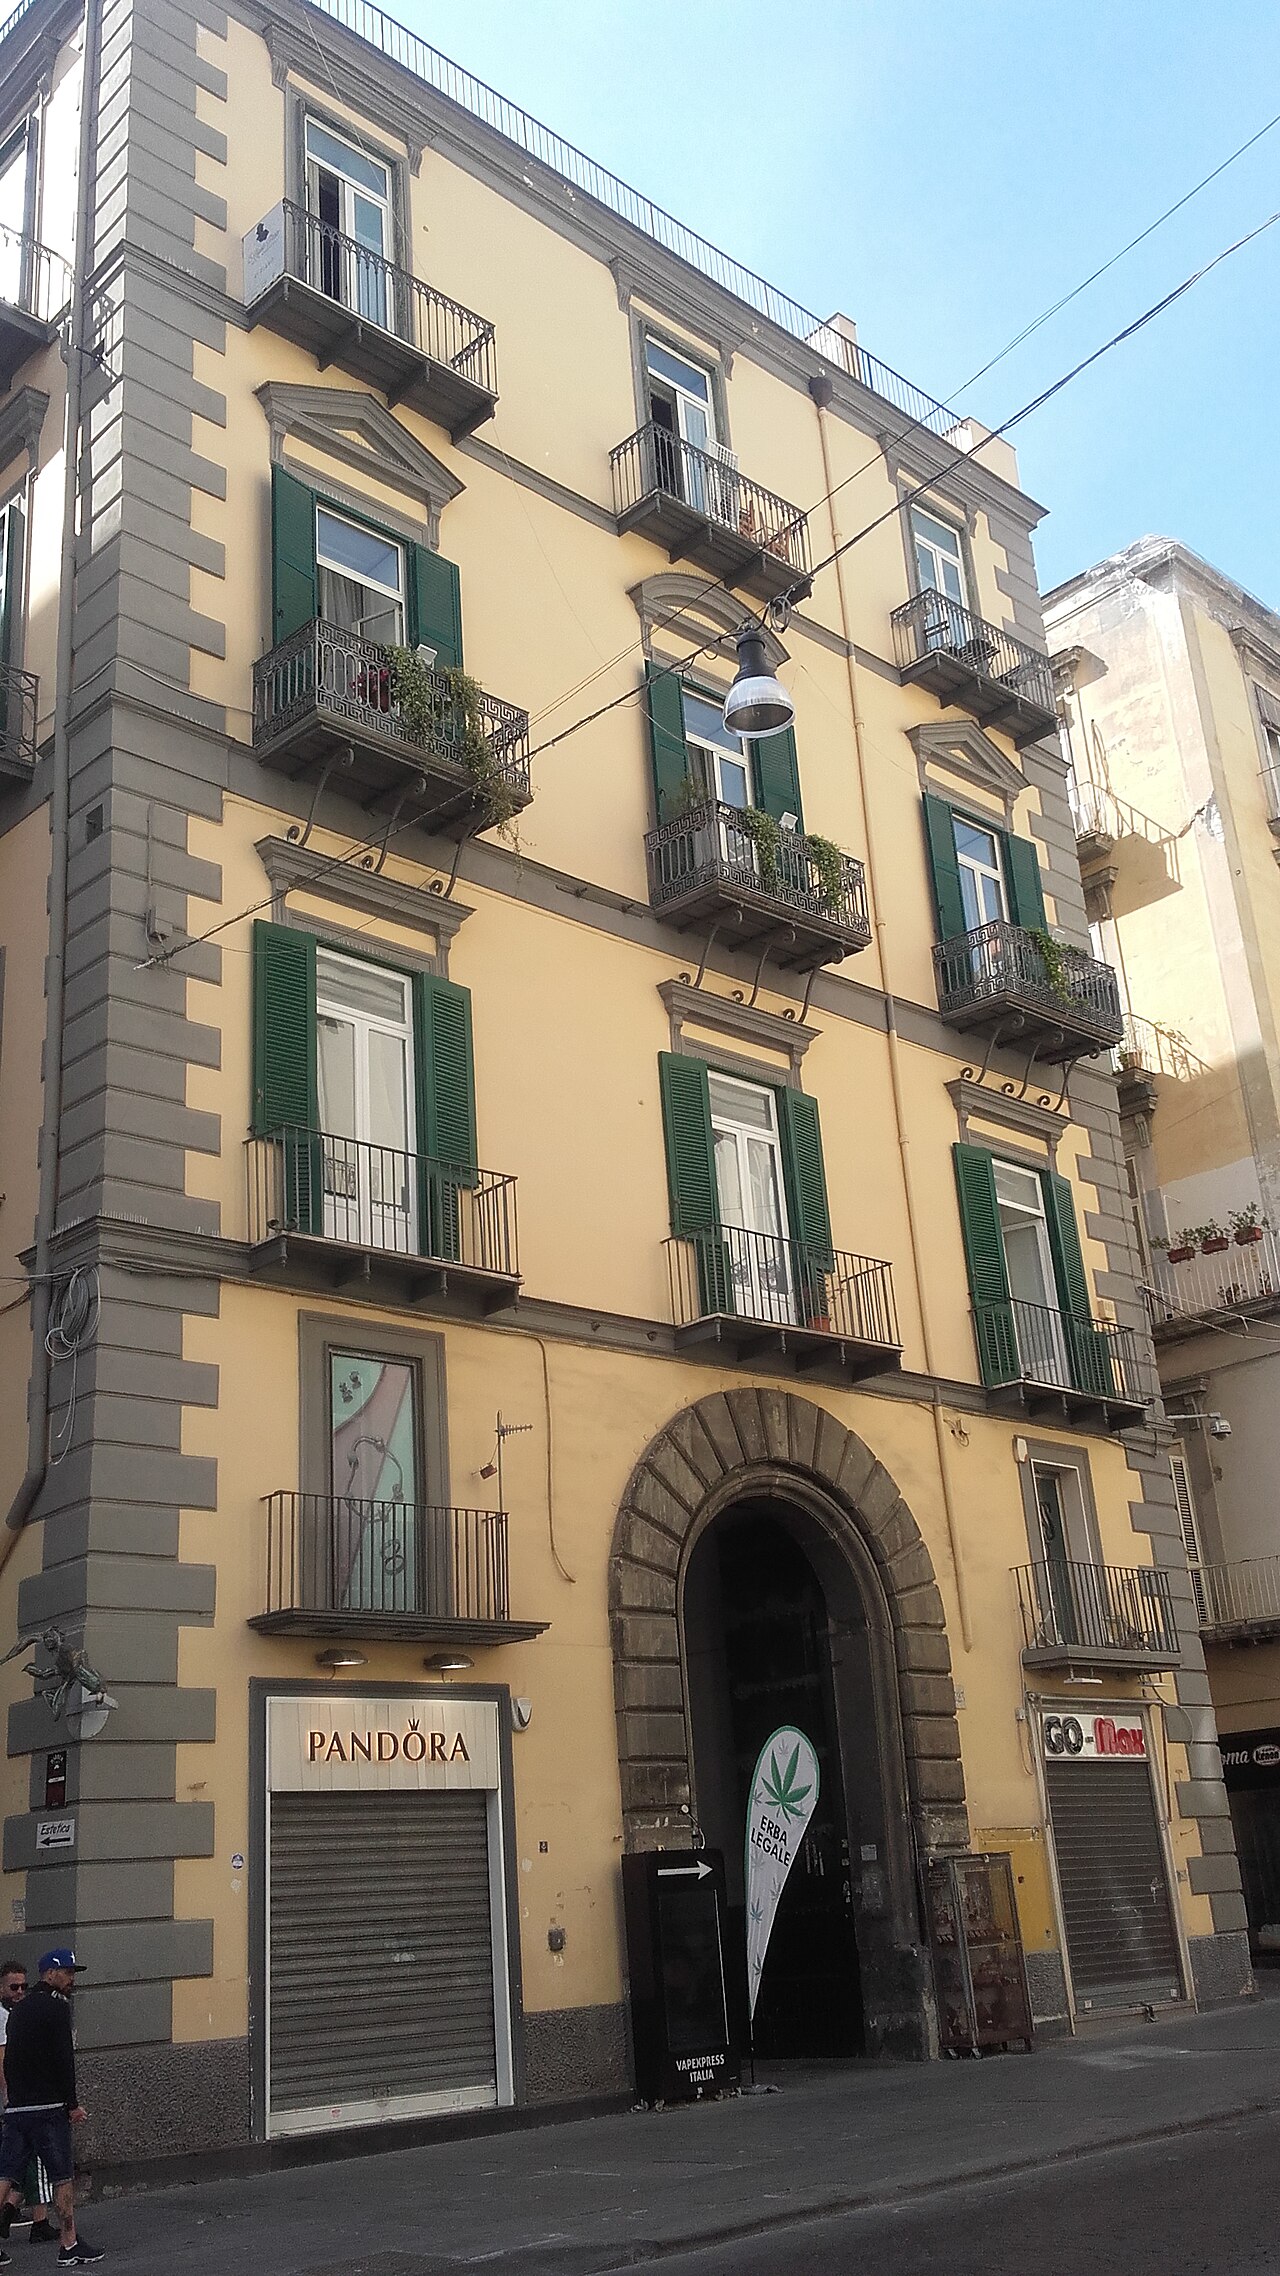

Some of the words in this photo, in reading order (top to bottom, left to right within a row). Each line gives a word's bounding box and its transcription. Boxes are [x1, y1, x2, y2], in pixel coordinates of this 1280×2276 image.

[308, 1730, 471, 1762] PANDORA
[40, 1822, 71, 1835] Estetica
[760, 1815, 787, 1847] ERBA
[750, 1827, 791, 1867] LEGALE
[675, 2053, 725, 2071] VAPEXPRESS
[689, 2068, 715, 2083] ITALIA
